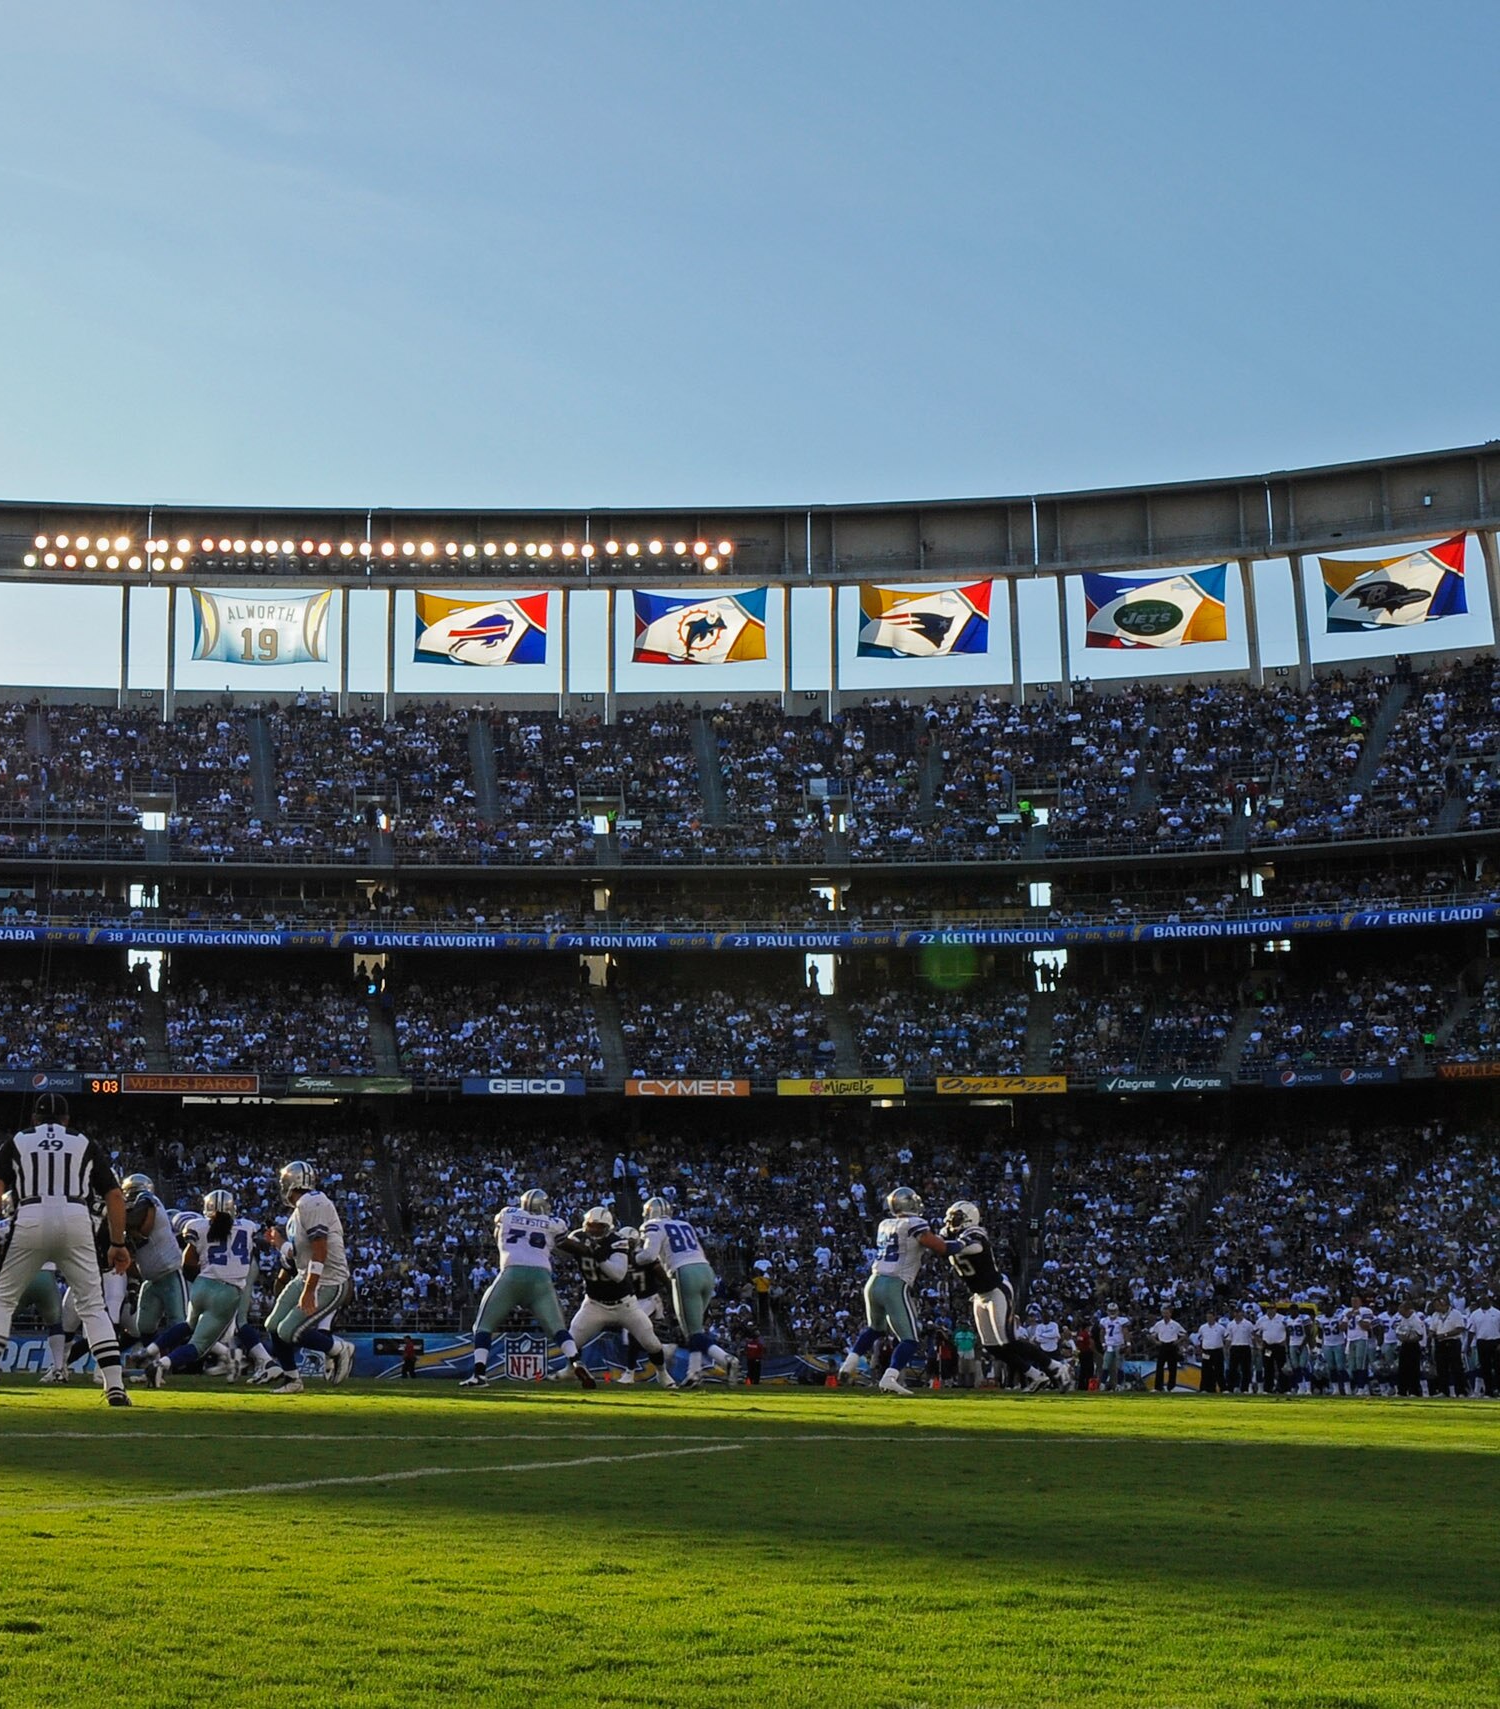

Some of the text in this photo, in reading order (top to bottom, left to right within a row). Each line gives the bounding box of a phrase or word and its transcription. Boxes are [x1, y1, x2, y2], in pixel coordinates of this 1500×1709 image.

[227, 605, 296, 622] ALWORTH
[1122, 613, 1171, 625] JETS
[241, 627, 278, 661] 19
[1364, 914, 1380, 925] 77
[1388, 911, 1436, 925] ERNIE
[1440, 907, 1483, 922] LADD
[1154, 921, 1282, 938] BARRON HILTON
[107, 932, 281, 945] 38 JACQUE MacKINNON
[353, 935, 496, 947] 19 LANCE ALWORTH
[568, 936, 657, 947] 74 RON MIX
[734, 935, 841, 946] 23 PAUL LOWE
[919, 931, 1055, 944] 22 KEITH LINCOLN
[1357, 1071, 1383, 1082] pepsi
[1439, 1063, 1500, 1078] WELLS
[49, 1077, 74, 1087] pepsi
[129, 1078, 250, 1090] WELLS FARGO
[295, 1076, 334, 1089] Sycuan
[1003, 1077, 1060, 1091] Pizza
[1183, 1077, 1221, 1090] Degree
[1297, 1073, 1322, 1083] pepsi
[488, 1079, 565, 1094] GEICO
[638, 1080, 736, 1095] CYMER
[1118, 1079, 1156, 1091] Degree
[37, 1140, 64, 1151] 49
[510, 1214, 550, 1230] BREWSTER
[664, 1223, 698, 1252] 80
[207, 1229, 250, 1266] 24
[1107, 1324, 1116, 1337] 7
[1323, 1322, 1340, 1335] 53
[510, 1354, 544, 1378] NFL
